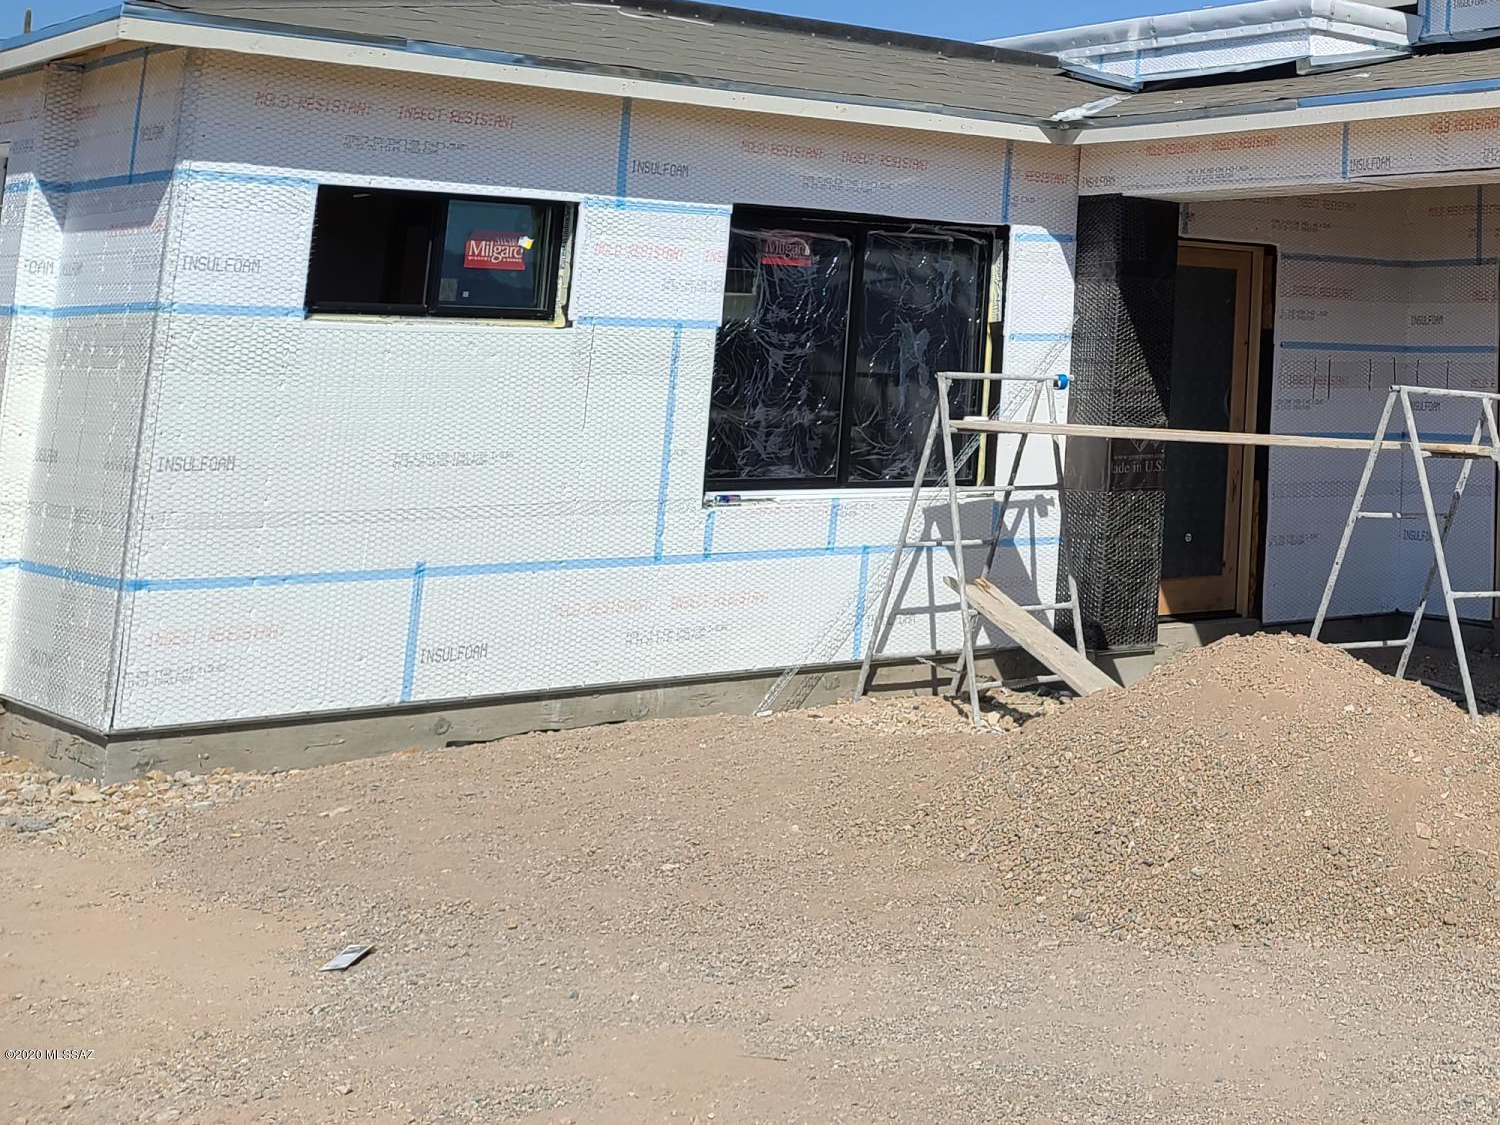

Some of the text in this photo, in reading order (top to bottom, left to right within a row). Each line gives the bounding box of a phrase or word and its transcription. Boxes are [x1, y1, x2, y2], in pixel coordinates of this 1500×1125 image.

[299, 94, 371, 116] RESISTANT
[399, 105, 443, 122] INSECT
[449, 109, 516, 129] RESISTANT
[631, 160, 689, 178] INSULFOAM
[879, 155, 929, 171] RESISTANT
[1350, 156, 1391, 172] INSULFOAM
[182, 255, 261, 274] INSULFOAM
[1411, 315, 1444, 326] INSULFOAM
[157, 455, 236, 472] INSULFOAM
[1113, 461, 1130, 474] ade
[1133, 460, 1142, 473] in
[420, 643, 488, 665] INSULFOAM
